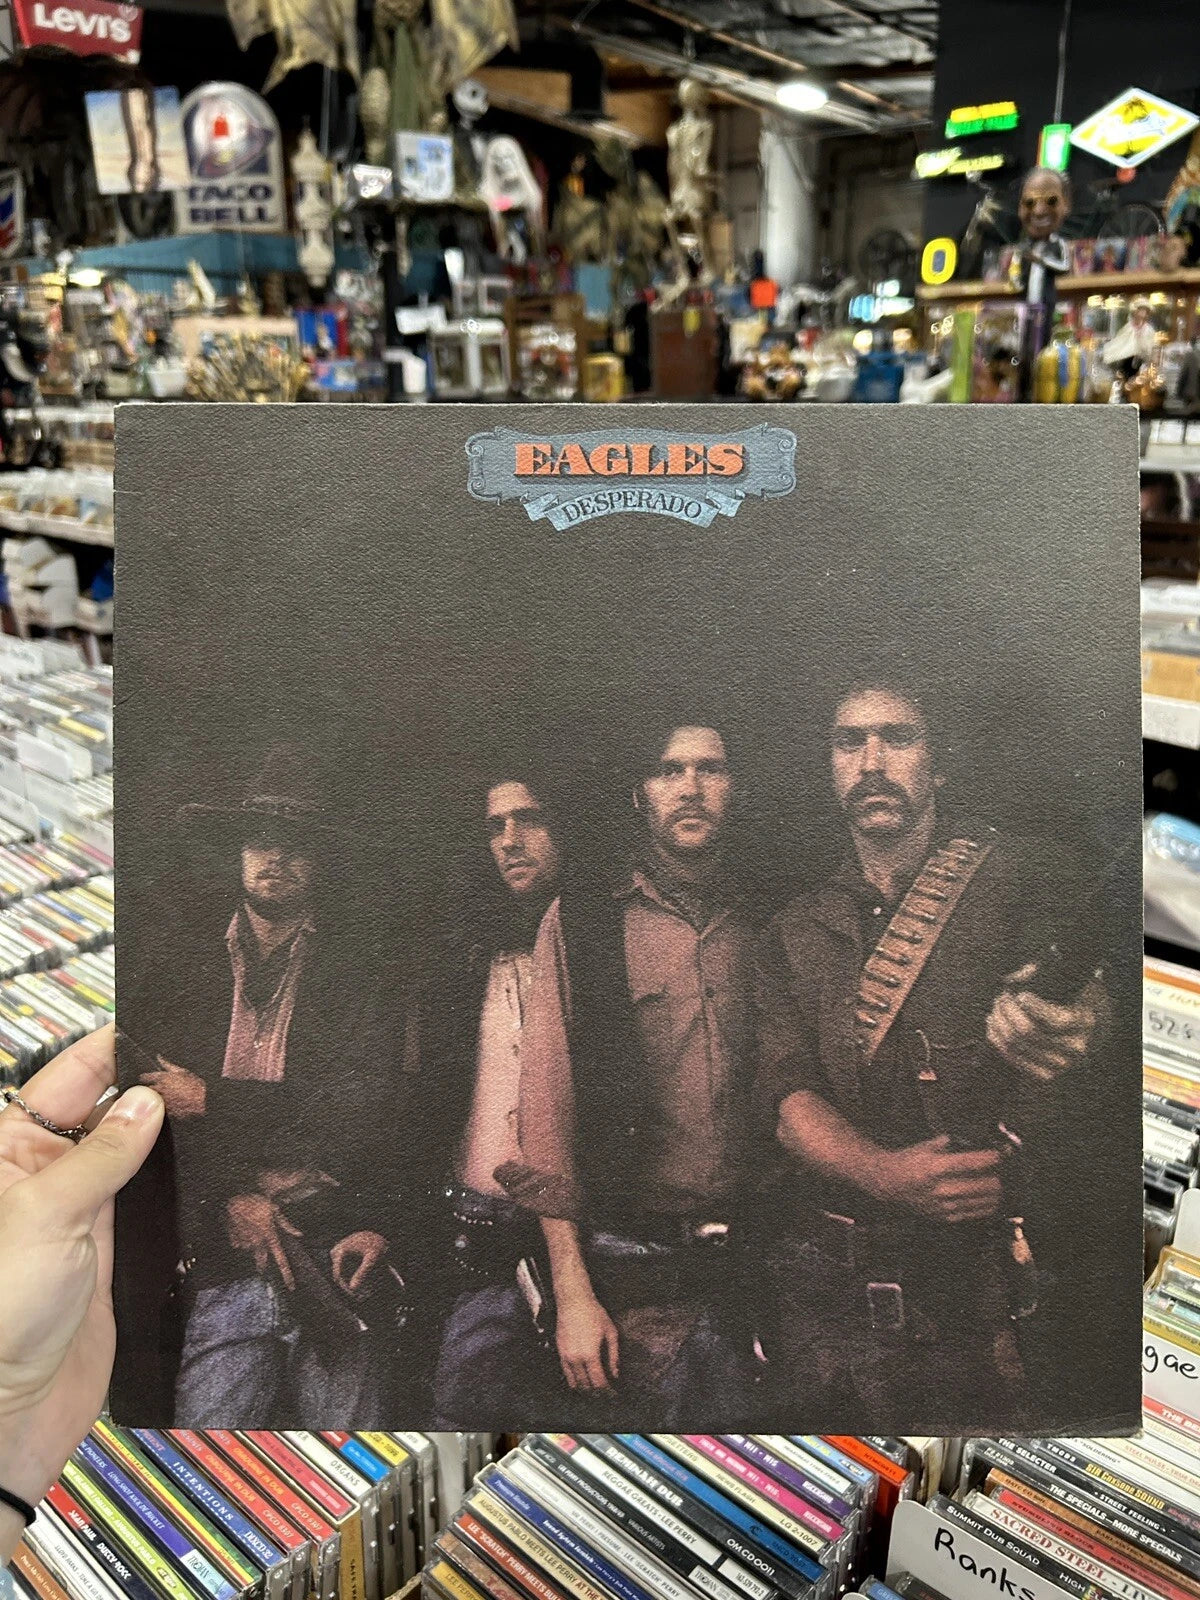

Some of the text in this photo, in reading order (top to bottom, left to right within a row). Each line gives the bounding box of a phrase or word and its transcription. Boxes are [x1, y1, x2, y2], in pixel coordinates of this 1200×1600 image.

[187, 183, 271, 201] TACO
[189, 206, 275, 224] BELL
[513, 442, 746, 479] EAGLES
[562, 489, 704, 524] DESPERADO
[108, 1471, 121, 1484] LONG
[172, 1460, 233, 1520] INTENTIONS
[330, 1459, 359, 1485] ORGANS
[657, 1484, 682, 1506] DUB
[998, 1437, 1013, 1449] THE
[1016, 1447, 1055, 1472] SELECTER
[1100, 1494, 1125, 1510] STREET
[1128, 1510, 1159, 1529] FEELING
[1085, 1463, 1101, 1476] SIR
[1135, 1490, 1164, 1509] SOUND
[602, 1469, 631, 1494] REGGAE
[631, 1492, 658, 1515] GREATS
[660, 1515, 675, 1528] LEE
[673, 1525, 696, 1544] PERRY
[715, 1473, 734, 1488] NEWS
[734, 1486, 755, 1502] FLASH
[779, 1518, 792, 1529] LG
[792, 1526, 816, 1546] 2-1007
[1049, 1484, 1065, 1497] THE
[1140, 1534, 1182, 1562] SPECIALS
[68, 1509, 130, 1579] SEAN PAUL DUTTY ROCK
[467, 1521, 480, 1533] LEE
[507, 1556, 528, 1575] PERRY
[525, 1572, 546, 1591] MEETS
[478, 1498, 598, 1600] AUGUSTUS PABLO MEETS LEE PERRY AT THE
[934, 1527, 1037, 1600] Ranks
[946, 1505, 983, 1530] SUMMIT
[983, 1528, 1004, 1543] DUB
[1006, 1542, 1040, 1564] SQUAD
[1059, 1573, 1085, 1591] HIGH
[990, 1509, 1053, 1548] SACRED
[1055, 1546, 1108, 1581] STEEL
[661, 1581, 679, 1597] PERRY
[694, 1570, 718, 1590] TROJAN
